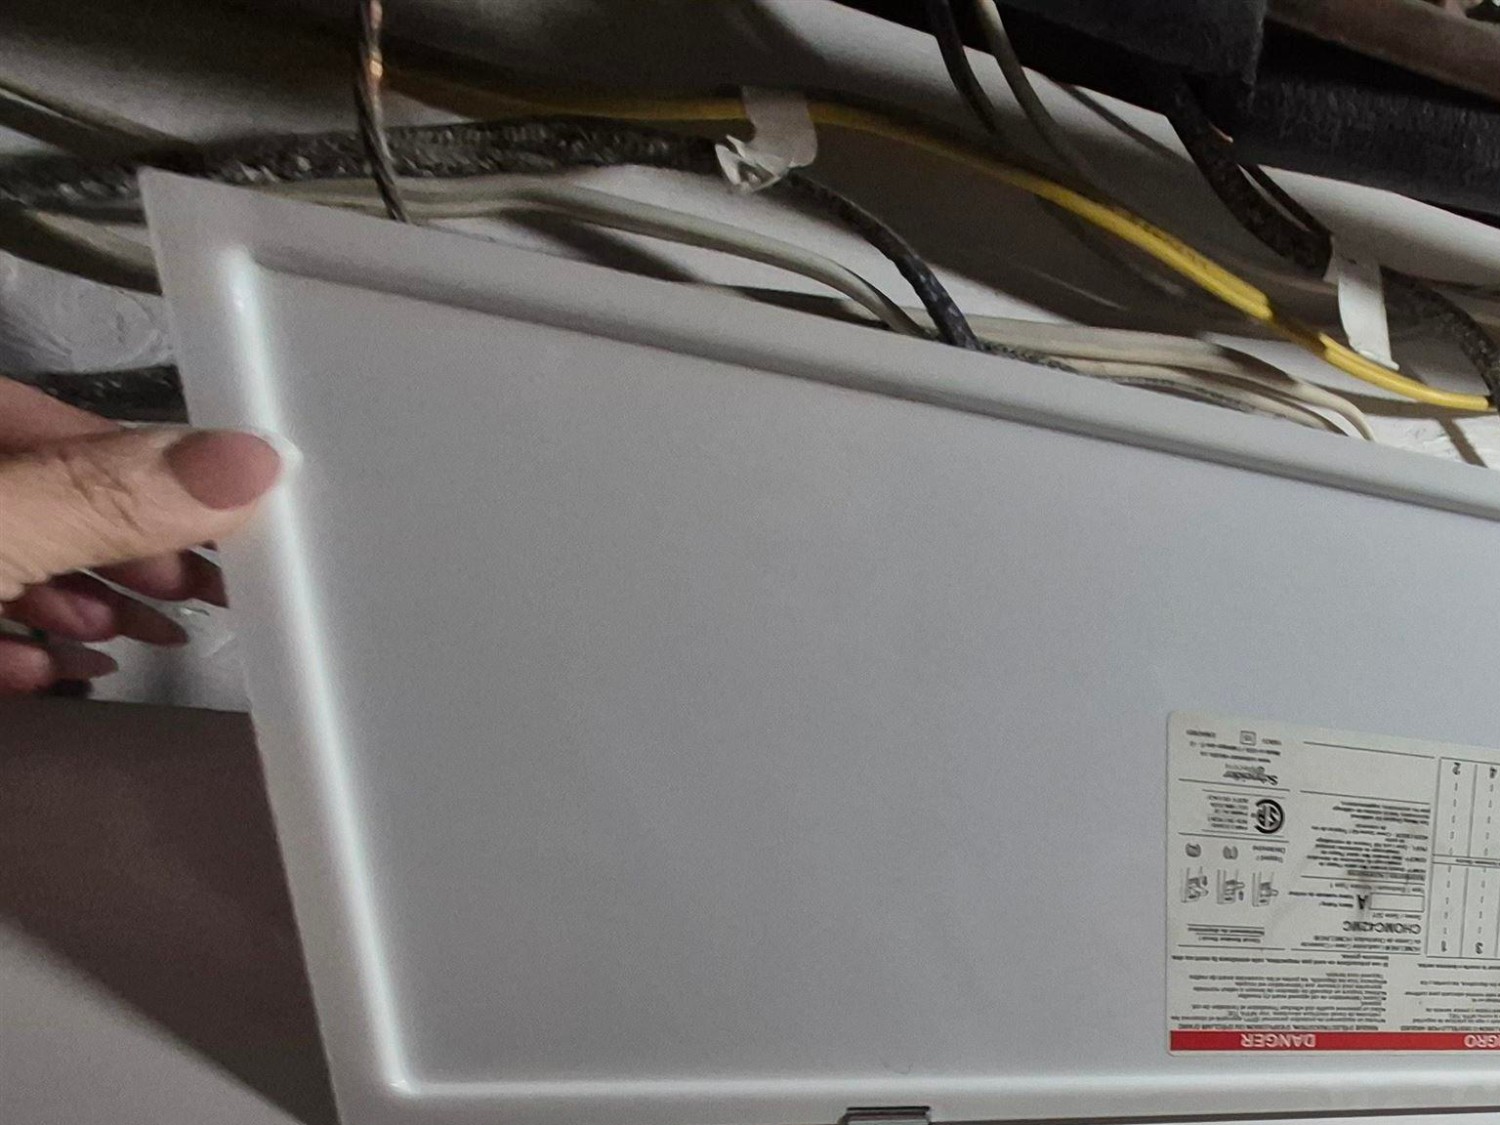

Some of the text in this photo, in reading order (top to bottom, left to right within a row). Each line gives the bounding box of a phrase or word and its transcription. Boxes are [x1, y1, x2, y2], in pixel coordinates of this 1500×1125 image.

[1453, 762, 1461, 775] 2
[1357, 894, 1369, 910] A
[1442, 941, 1446, 952] 1
[1476, 942, 1482, 954] 3
[1240, 1033, 1316, 1047] DANGER
